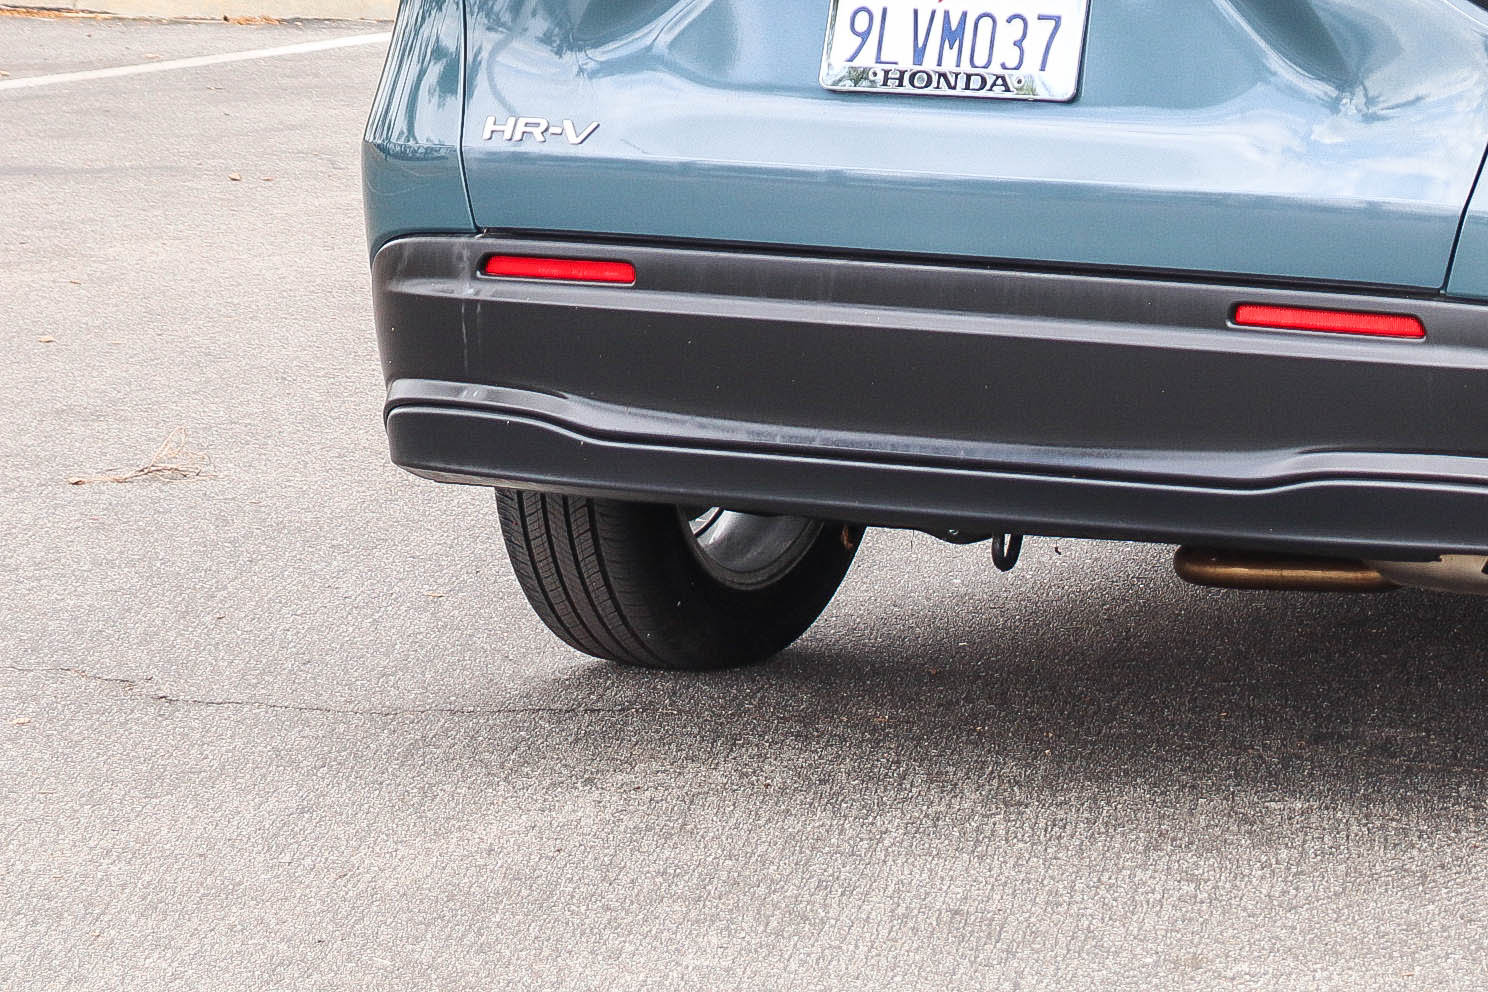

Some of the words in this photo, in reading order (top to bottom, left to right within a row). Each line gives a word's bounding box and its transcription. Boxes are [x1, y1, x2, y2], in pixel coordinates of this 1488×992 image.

[846, 6, 1062, 72] 9LVM037
[881, 68, 1015, 94] HONDA
[482, 115, 600, 146] HR-V
